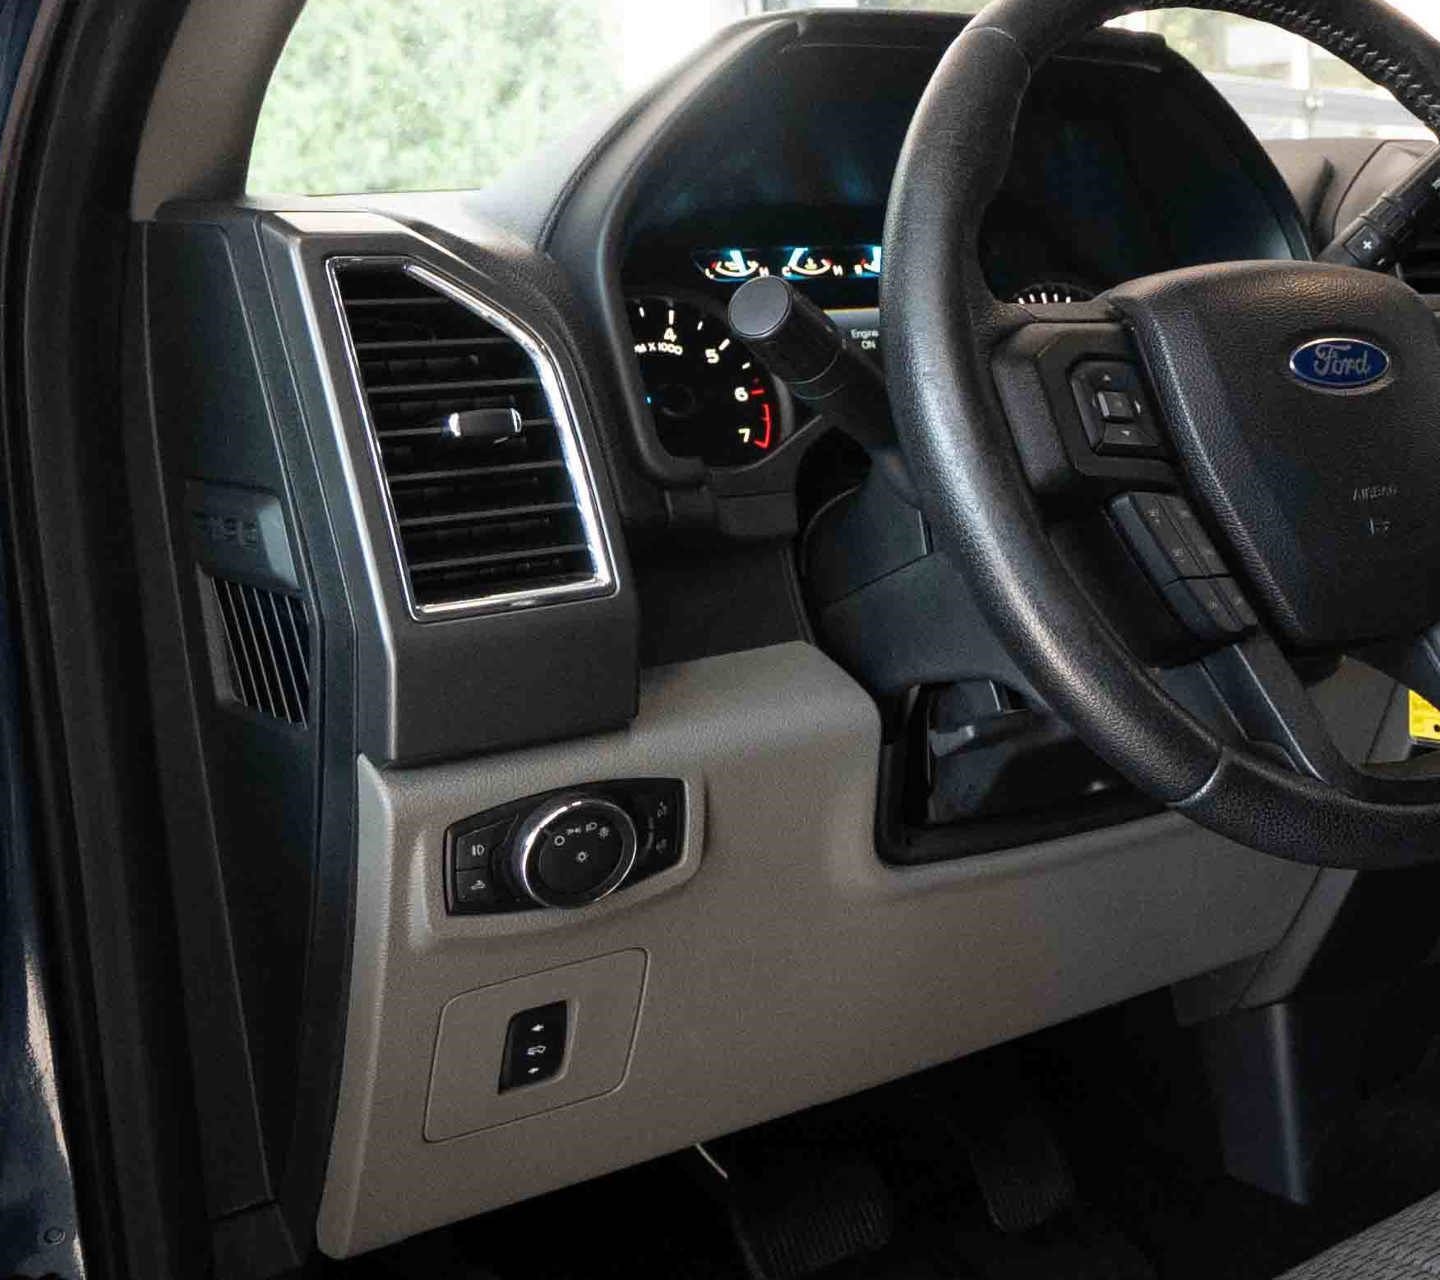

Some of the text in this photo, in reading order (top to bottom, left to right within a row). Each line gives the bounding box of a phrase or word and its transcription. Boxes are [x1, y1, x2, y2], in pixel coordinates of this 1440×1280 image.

[663, 326, 678, 343] 4
[705, 347, 720, 364] 5
[1312, 344, 1370, 377] Ford
[733, 386, 749, 402] 6
[738, 428, 751, 443] 7
